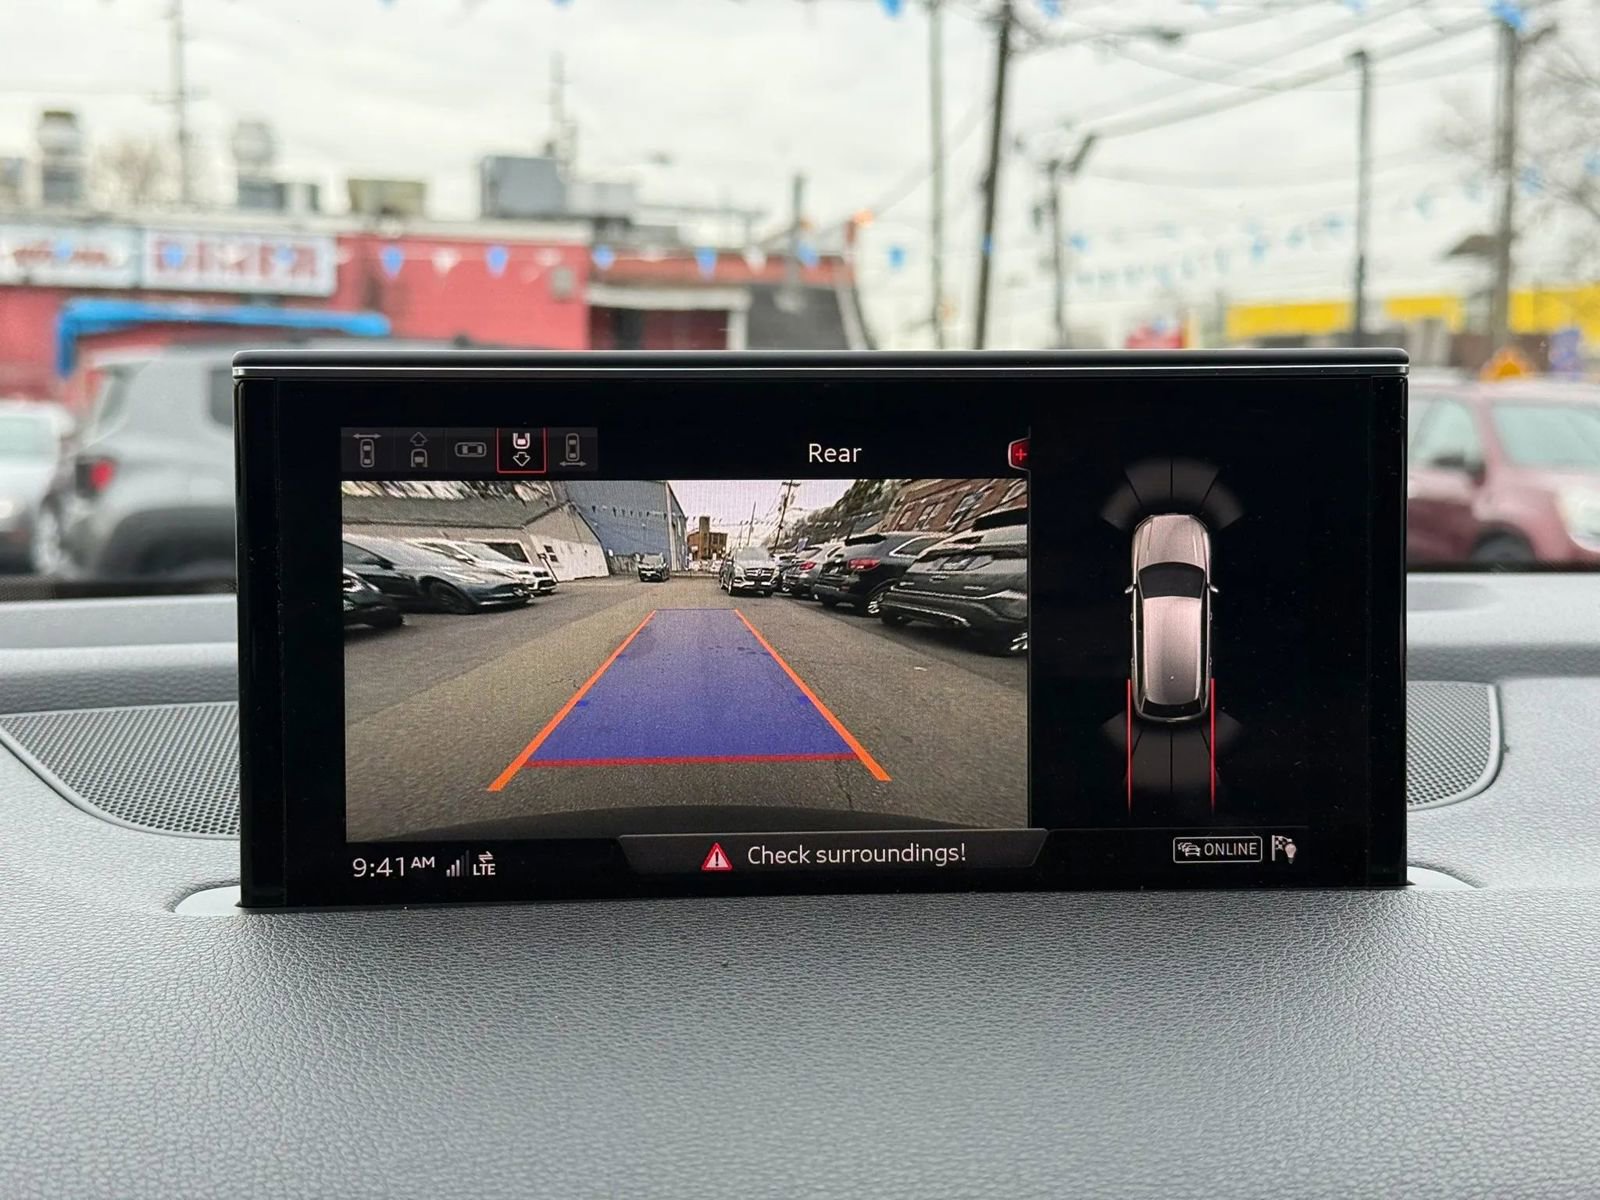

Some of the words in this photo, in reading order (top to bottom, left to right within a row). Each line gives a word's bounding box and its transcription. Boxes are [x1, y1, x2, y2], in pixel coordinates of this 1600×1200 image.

[808, 443, 863, 463] Rear
[747, 845, 811, 865] Check
[815, 843, 967, 867] surroundings!
[1203, 842, 1259, 856] ONLINE
[352, 856, 405, 877] 9:41
[410, 856, 436, 868] AM
[473, 864, 496, 875] LTE
